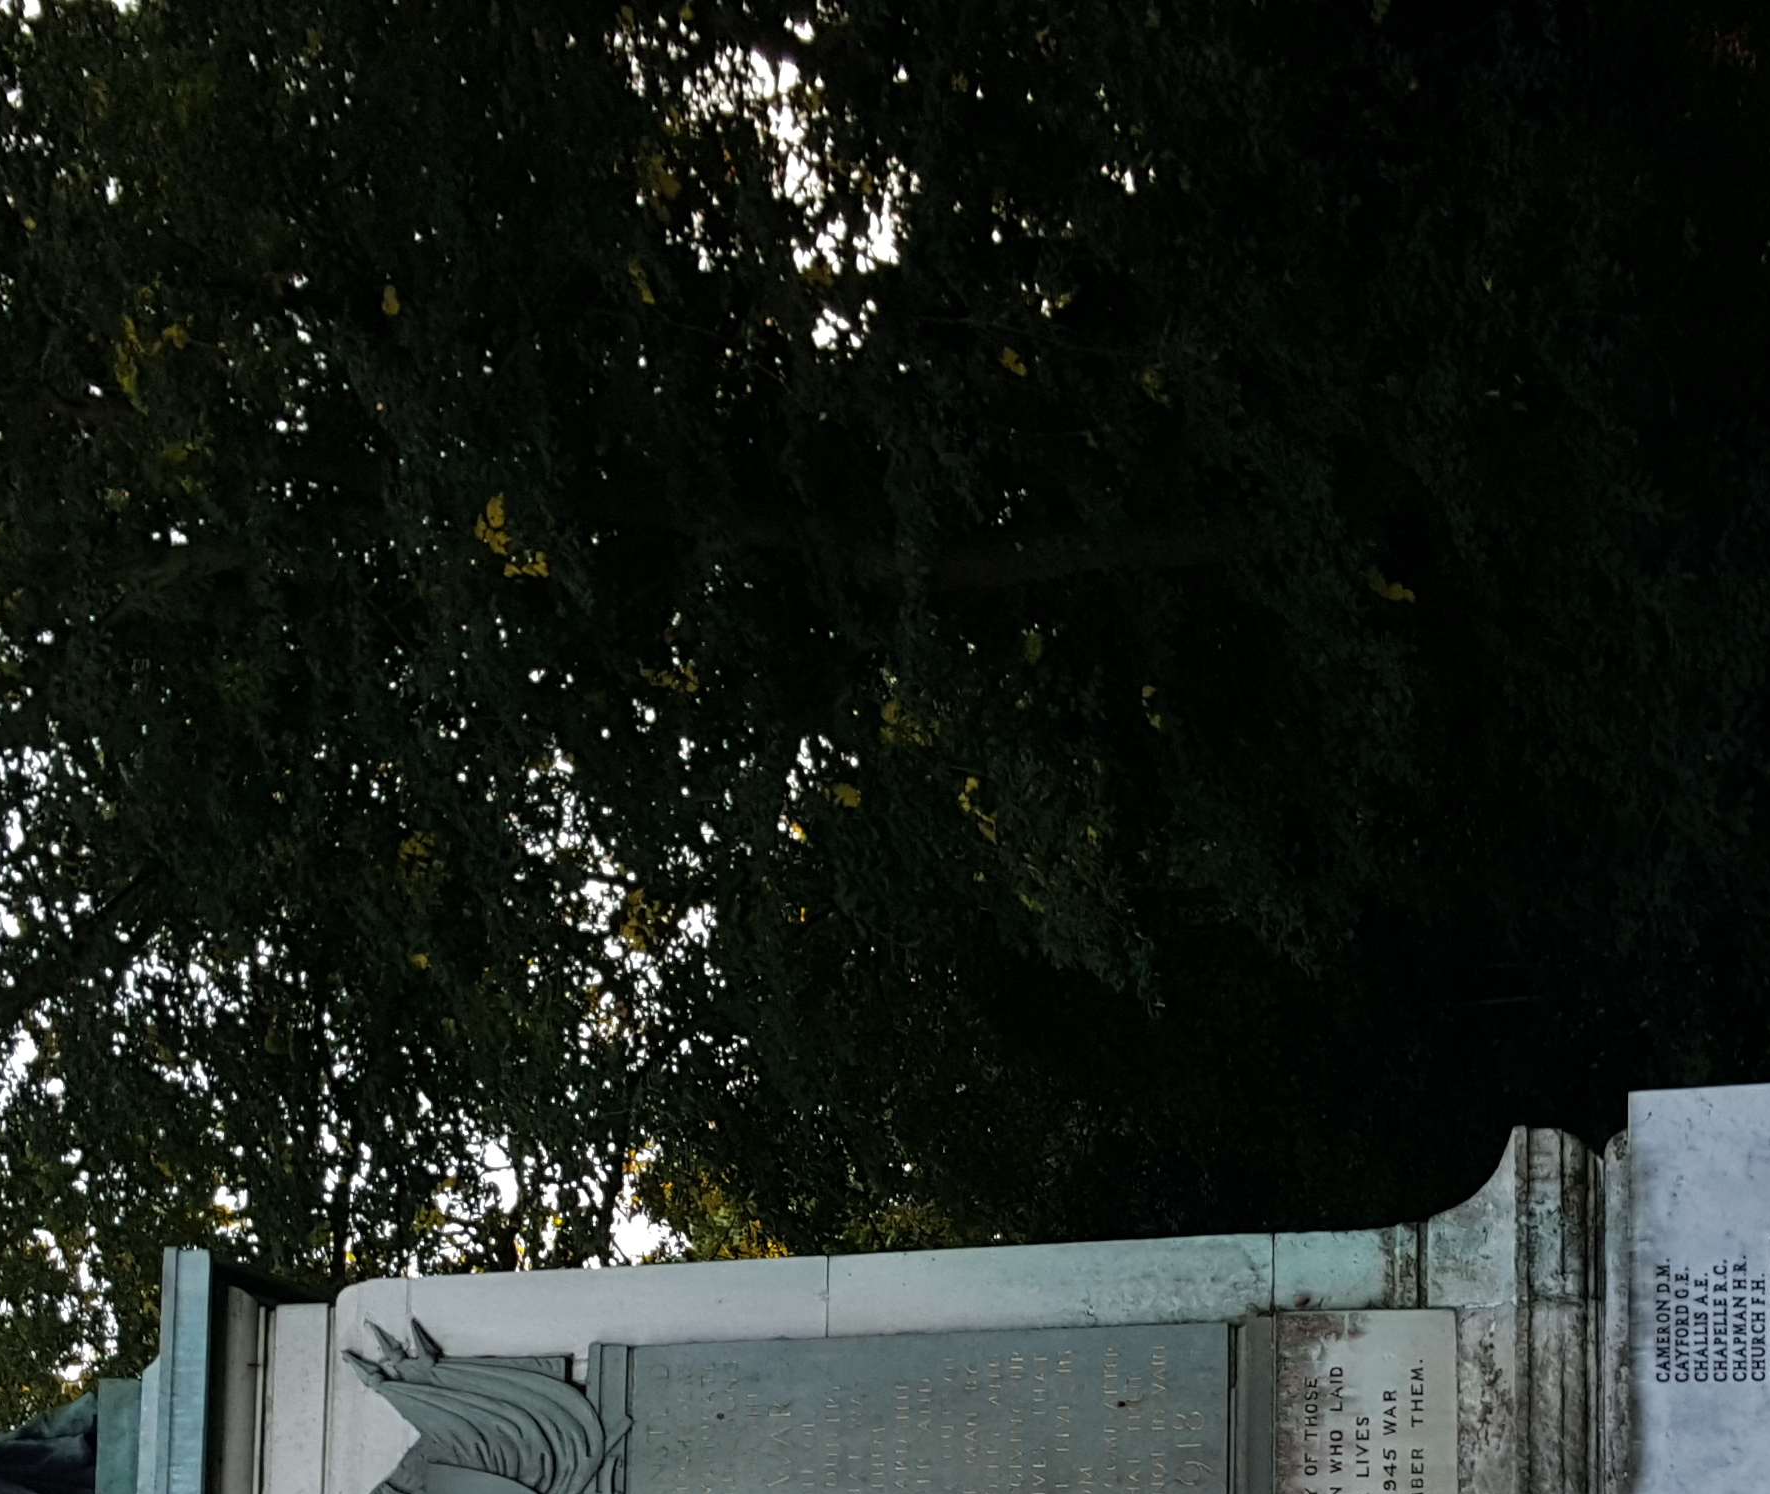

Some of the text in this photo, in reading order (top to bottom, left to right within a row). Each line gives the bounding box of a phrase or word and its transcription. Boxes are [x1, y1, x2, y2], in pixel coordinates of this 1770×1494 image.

[1655, 1258, 1670, 1383] CAMERON D.M.
[1674, 1266, 1689, 1383] CAYFORD G.E.
[1694, 1273, 1708, 1382] CHALLIS A.E.
[1713, 1259, 1727, 1382] CHAPELLE R.C.
[1733, 1296, 1747, 1382] CHAPMAN
[1751, 1273, 1765, 1382] CHURCH F.H.
[1303, 1377, 1318, 1441] THOSE
[1330, 1367, 1344, 1412] LAID
[1383, 1390, 1397, 1435] WAR
[1411, 1359, 1424, 1428] THEM.
[765, 1398, 793, 1487] WAR
[1305, 1452, 1318, 1476] OF
[1330, 1430, 1343, 1473] WHO
[1356, 1413, 1370, 1477] LIVES
